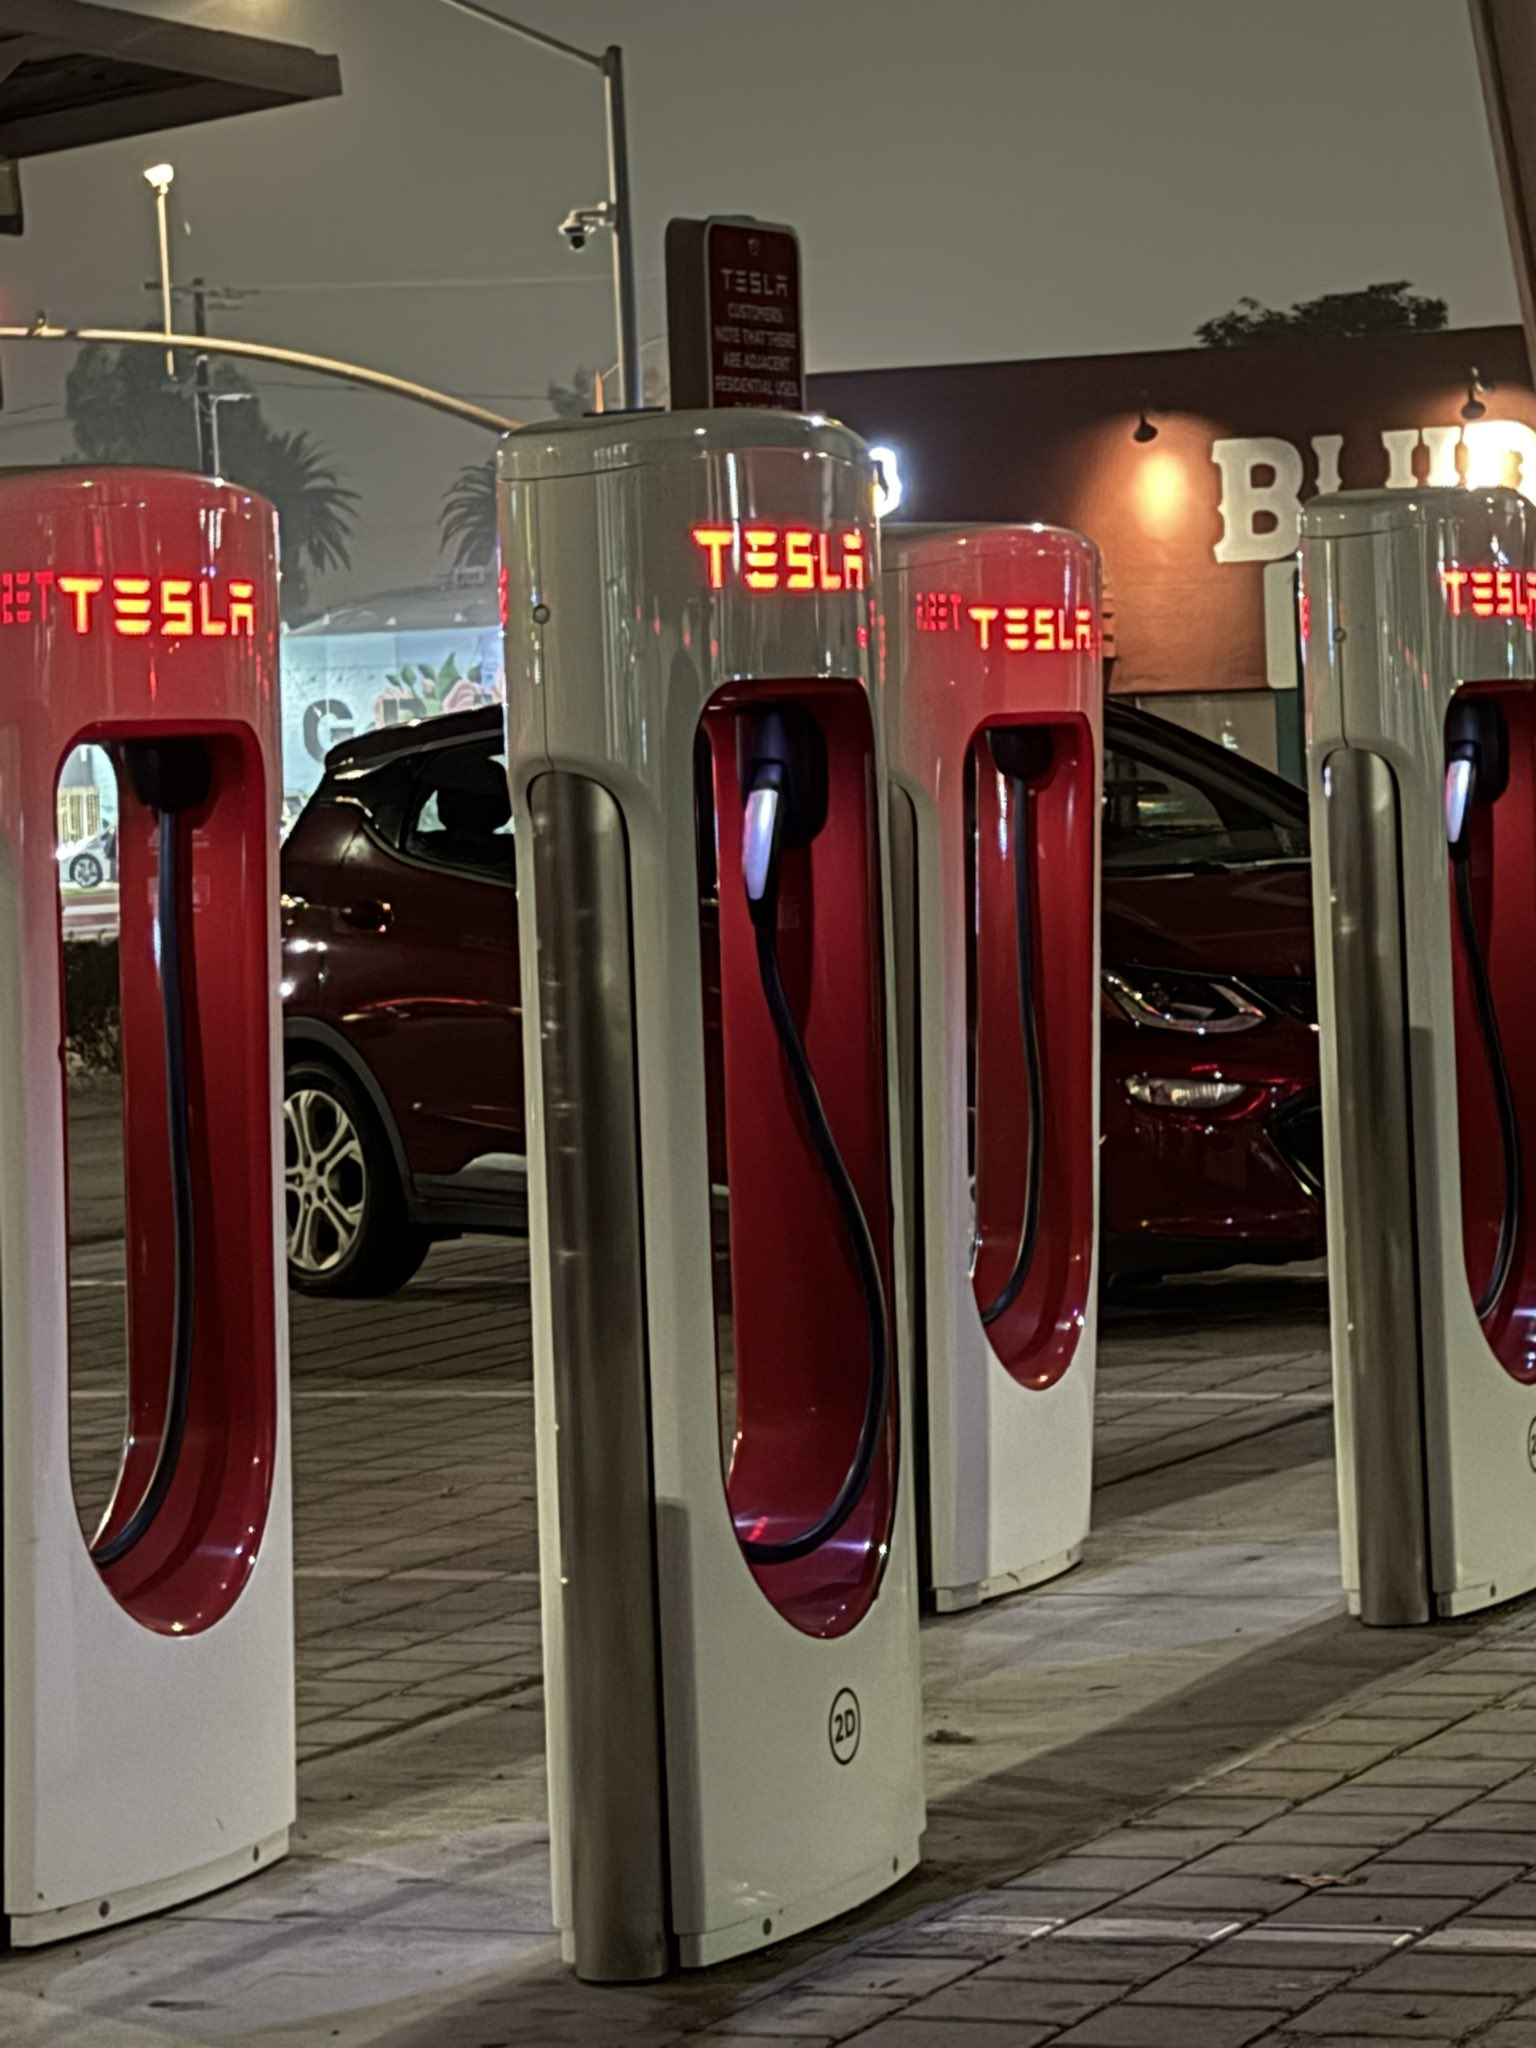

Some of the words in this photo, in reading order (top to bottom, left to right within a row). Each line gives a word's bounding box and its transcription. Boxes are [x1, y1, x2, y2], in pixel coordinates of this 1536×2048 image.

[720, 268, 788, 297] TESLA
[691, 528, 866, 591] TESLA
[57, 576, 255, 636] TESLA
[968, 607, 1091, 651] TESLA
[833, 1708, 856, 1744] 2D
